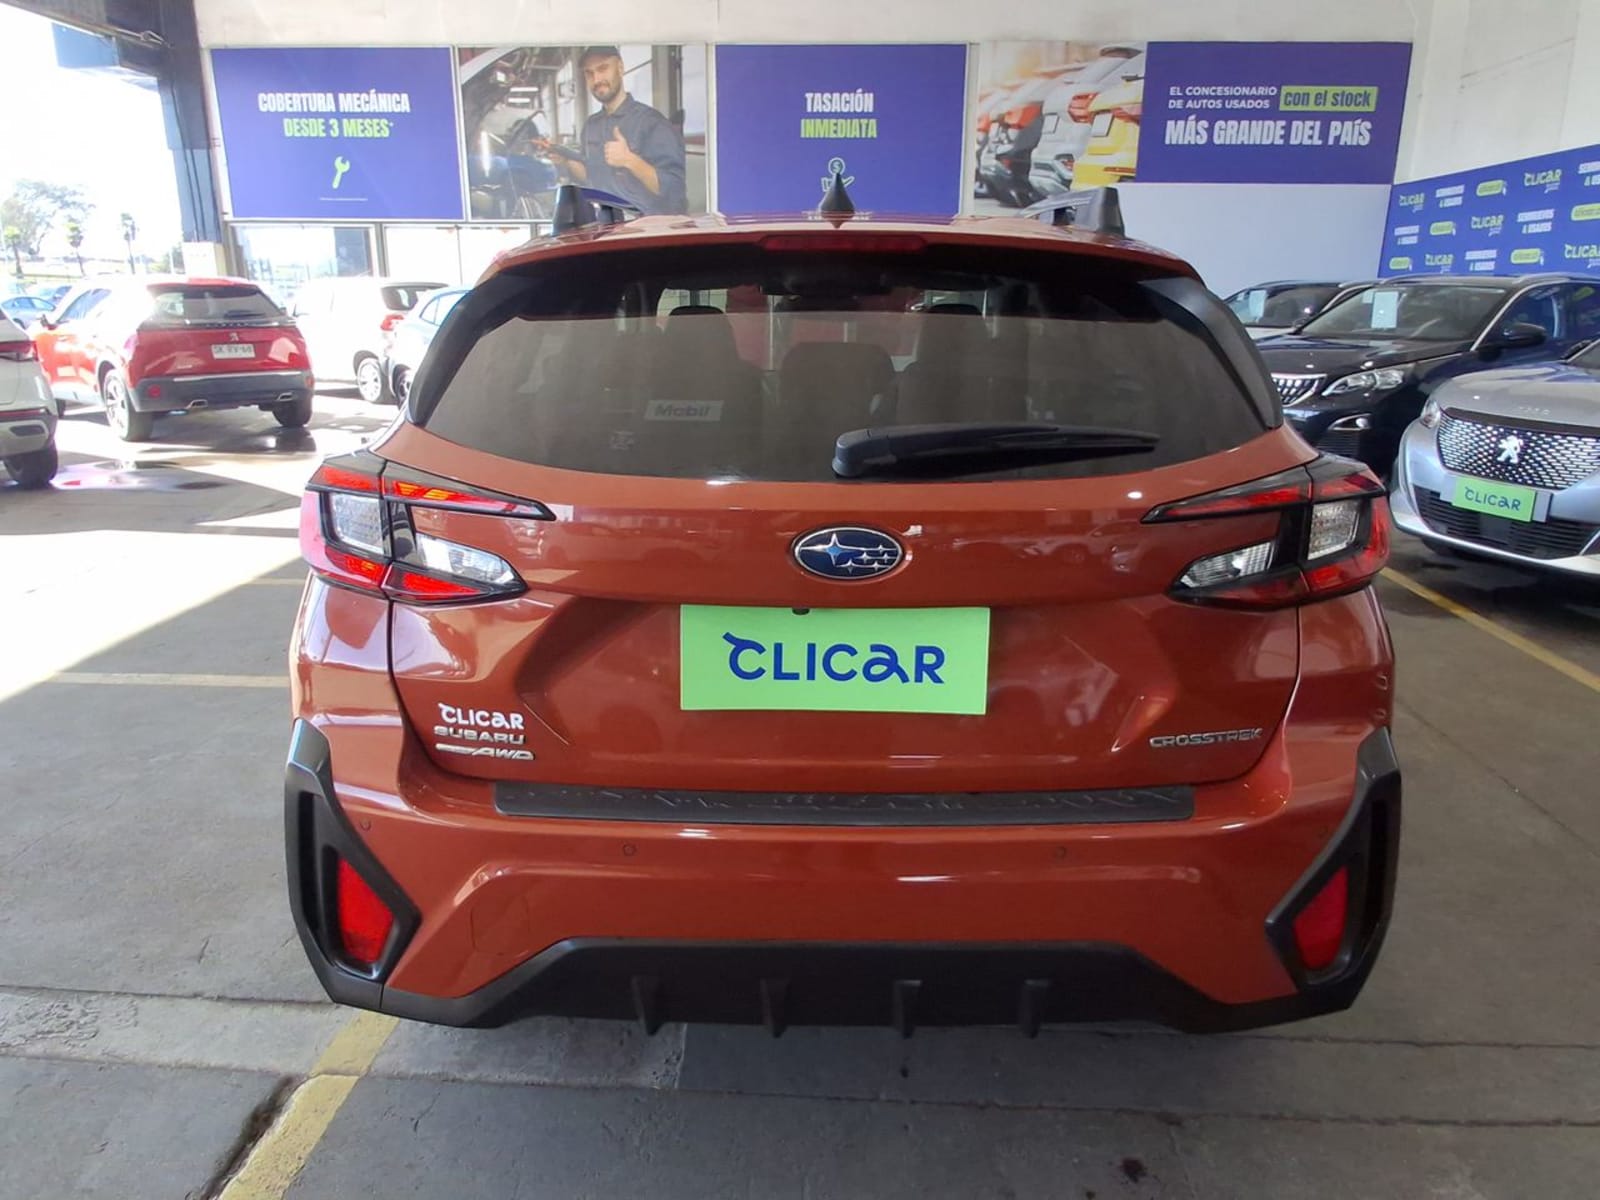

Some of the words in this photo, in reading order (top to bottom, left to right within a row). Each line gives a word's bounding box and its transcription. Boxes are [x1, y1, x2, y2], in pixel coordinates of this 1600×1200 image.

[257, 92, 336, 113] COBERTURA
[338, 88, 411, 113] MECÁNICA
[805, 88, 874, 112] TASACIÓN
[1169, 86, 1183, 96] EL
[1185, 86, 1278, 96] CONCESIONARIO
[1283, 91, 1311, 107] con
[1313, 89, 1327, 107] el
[1331, 90, 1371, 108] stock
[1168, 99, 1184, 109] DE
[1185, 99, 1222, 109] AUTOS
[1224, 99, 1271, 109] USADOS
[283, 118, 327, 137] DESDE
[329, 118, 339, 137] 3
[800, 118, 877, 139] INMEDIATA
[1164, 114, 1208, 145] MÁS
[1212, 120, 1287, 145] GRANDE
[1289, 120, 1323, 146] DEL
[1327, 118, 1373, 146] PAÍS
[654, 404, 711, 417] Mobil
[434, 725, 525, 745] SUBARU
[1149, 727, 1263, 748] CROSSTREK
[472, 746, 535, 761] AWD
